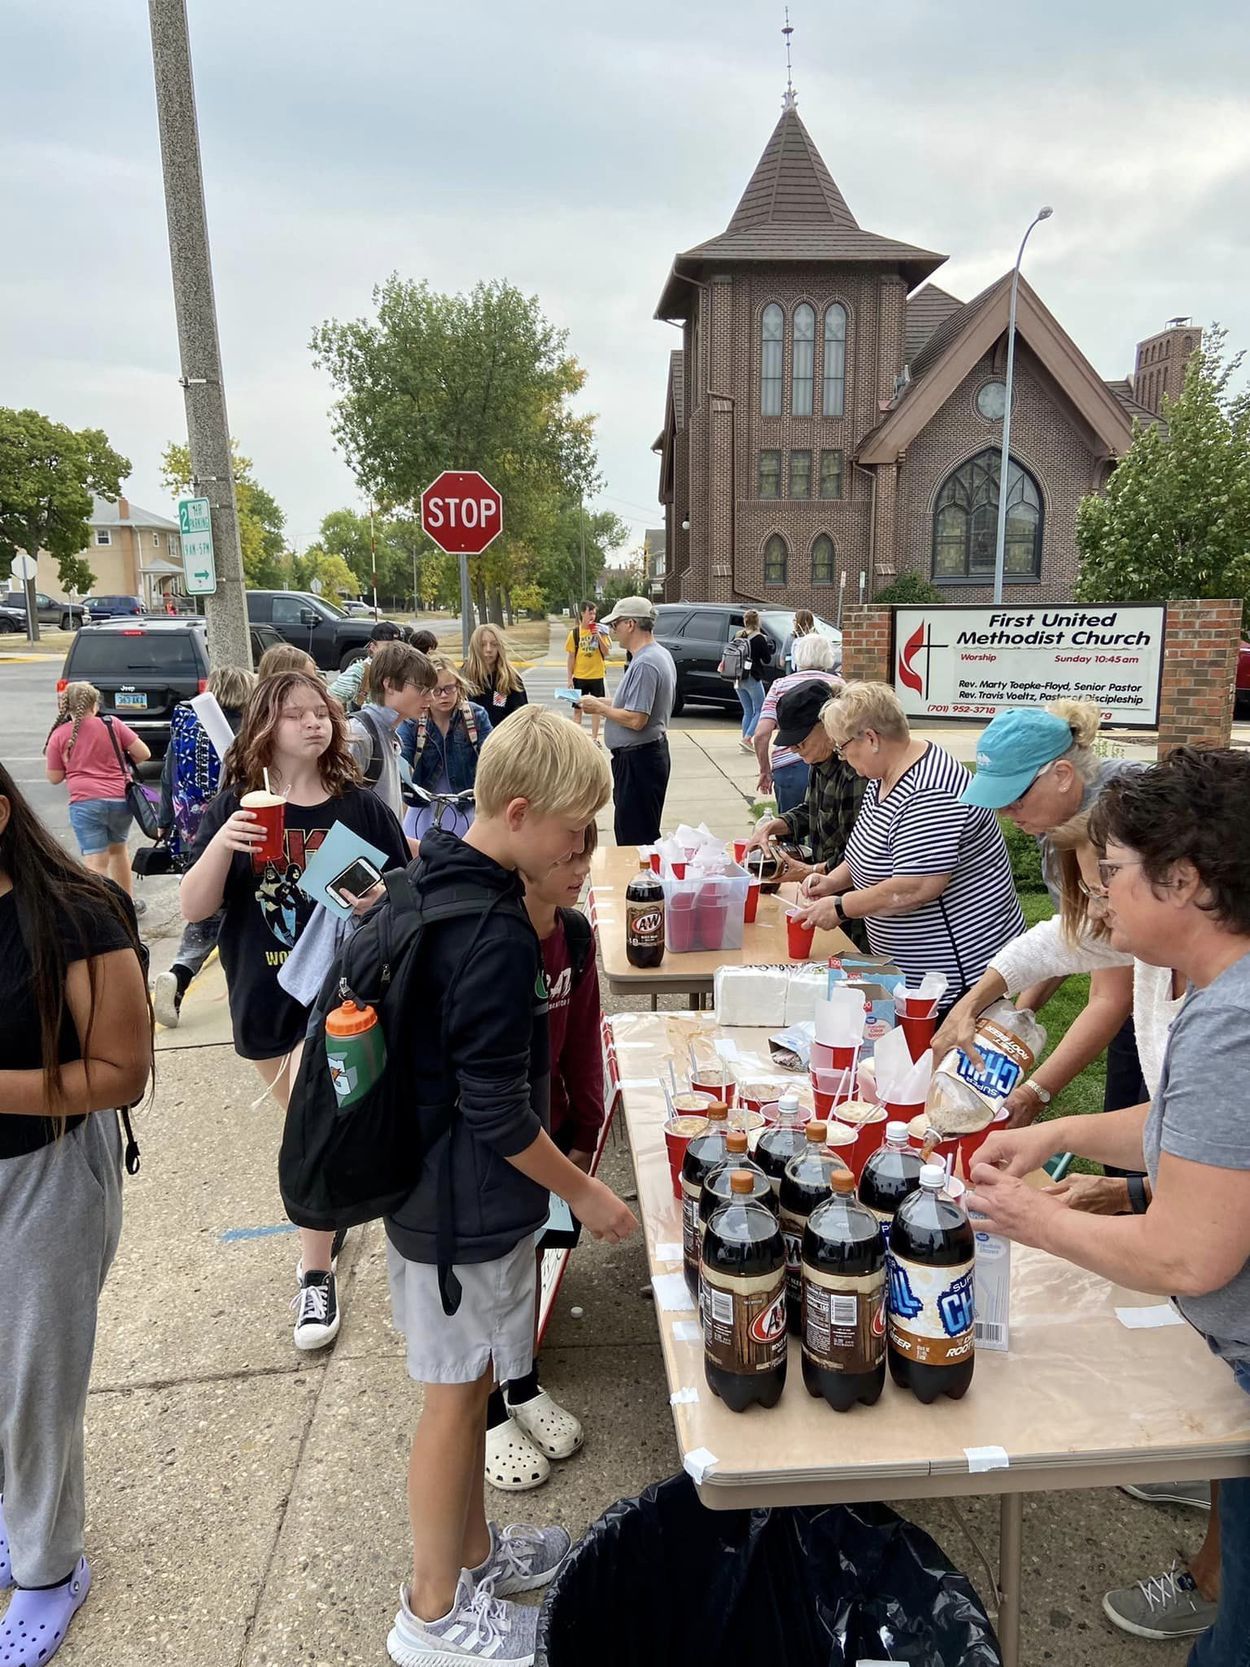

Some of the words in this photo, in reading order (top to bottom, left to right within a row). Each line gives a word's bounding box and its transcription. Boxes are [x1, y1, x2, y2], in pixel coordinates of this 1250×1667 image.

[181, 508, 189, 530] 2
[428, 497, 496, 528] STOP
[989, 613, 1035, 627] First
[1042, 612, 1118, 627] United
[956, 630, 1065, 645] Methodist
[1071, 630, 1151, 645] Church
[961, 654, 997, 662] Worship
[1054, 655, 1092, 664] Sunday
[959, 680, 977, 688] Rev.
[980, 680, 1007, 690] Marty
[1010, 681, 1071, 692] Toepke-Floyd,
[1074, 682, 1106, 691] Senior
[1108, 683, 1142, 692] Pastor
[959, 691, 976, 699] Rev.
[979, 691, 1004, 700] Travis
[1006, 692, 1037, 701] Voeltz,
[927, 704, 949, 713] (701)
[952, 705, 996, 714] 952-3718
[985, 1026, 1009, 1042] BEER
[1007, 1038, 1029, 1060] ROOT
